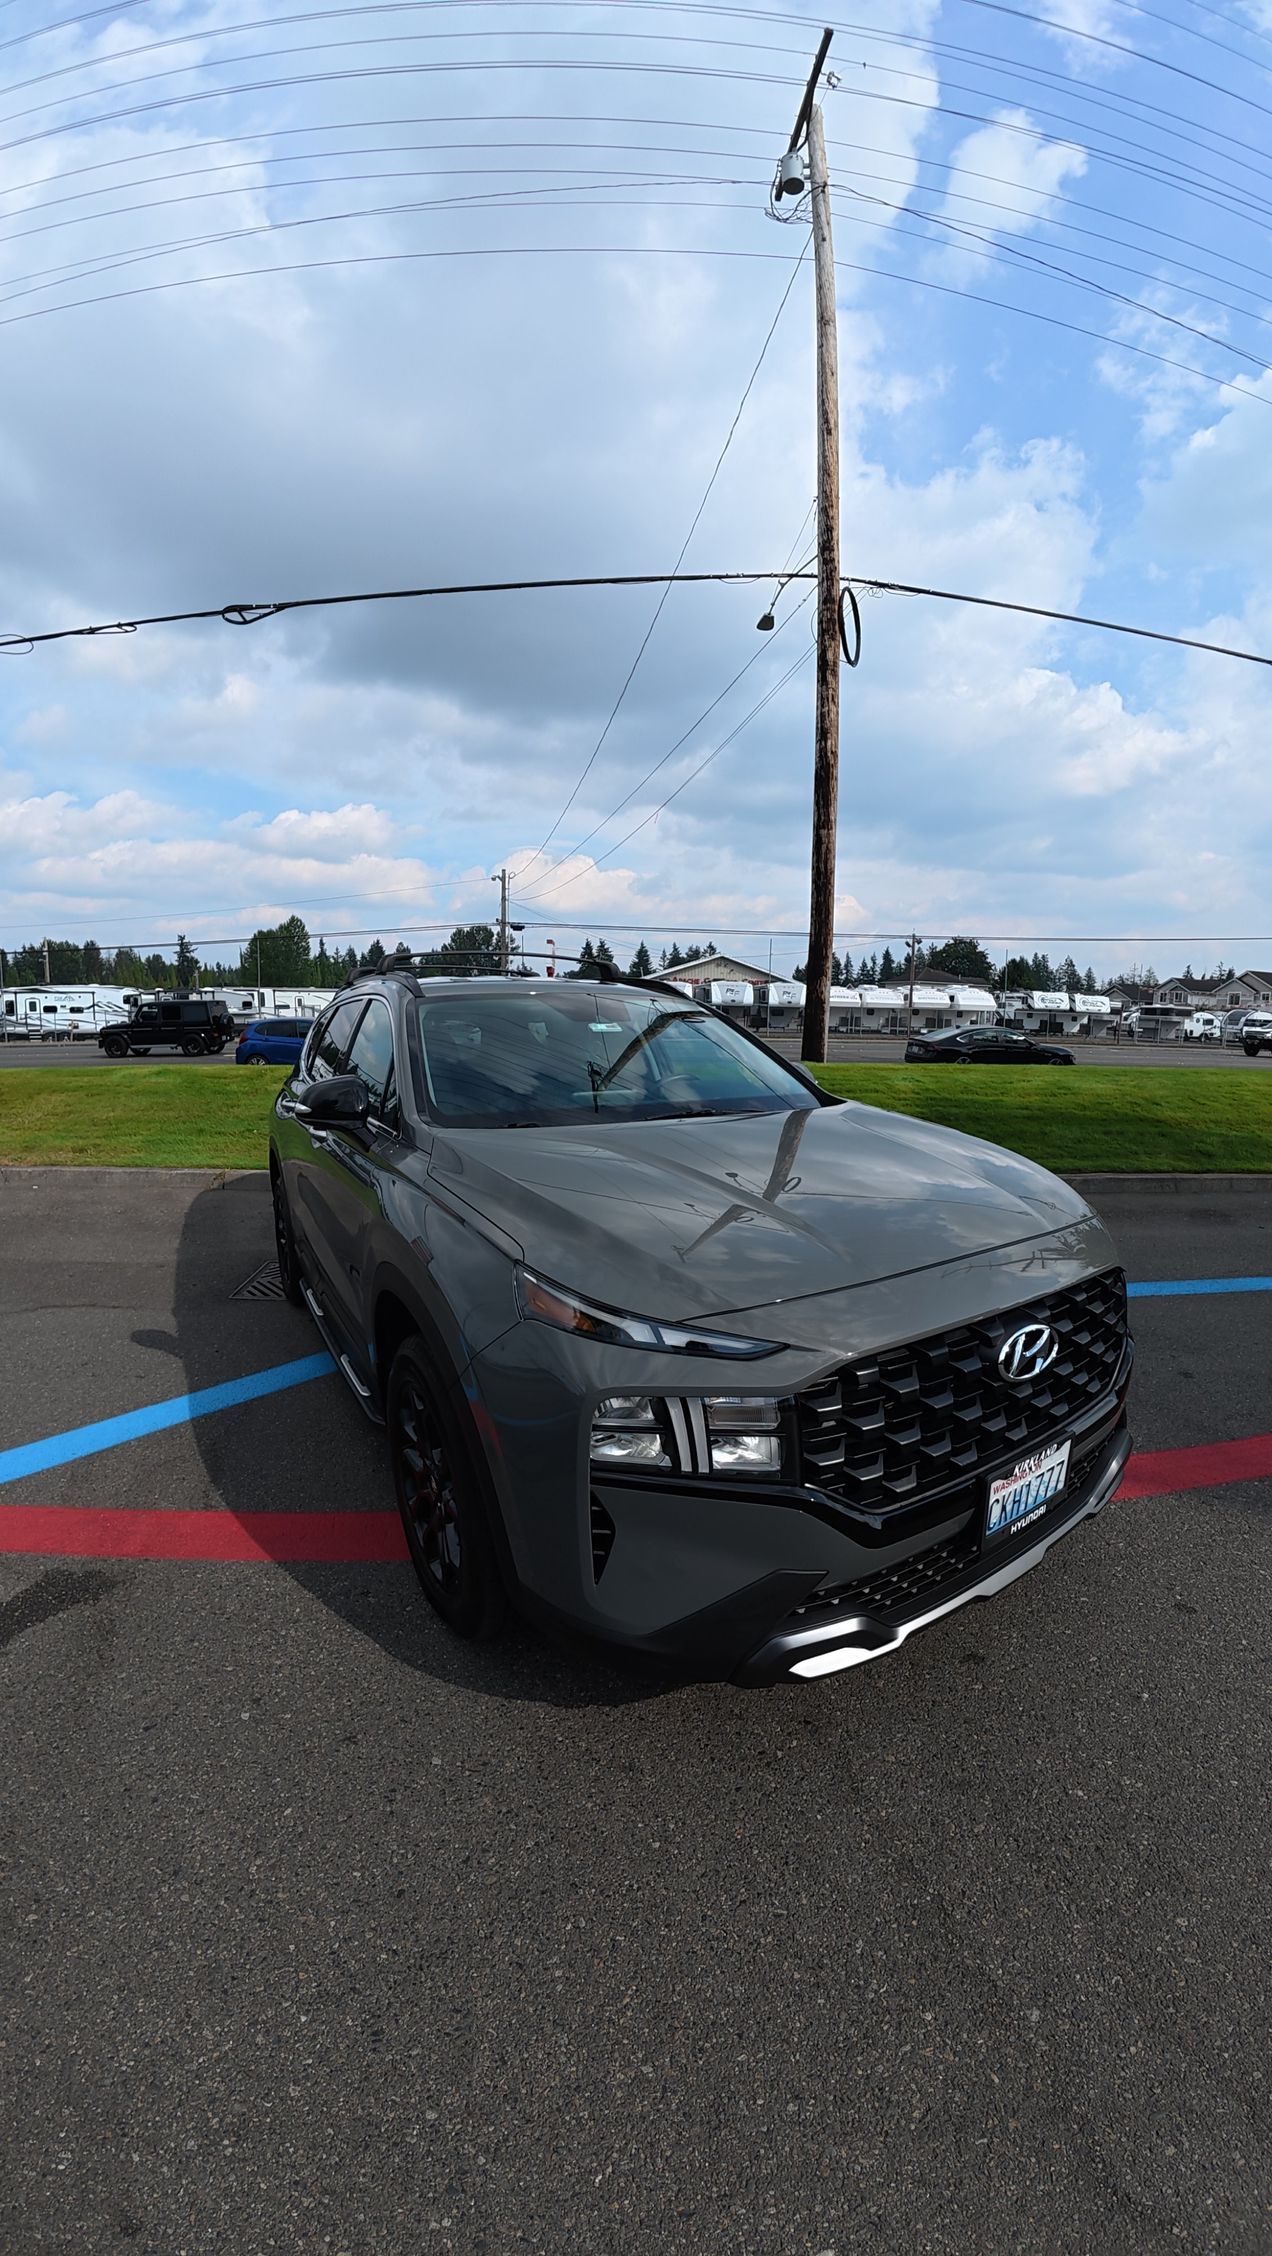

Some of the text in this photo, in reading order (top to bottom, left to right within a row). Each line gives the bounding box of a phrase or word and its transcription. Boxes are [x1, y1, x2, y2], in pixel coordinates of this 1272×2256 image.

[993, 1460, 1042, 1496] WASHINGN
[1012, 1443, 1058, 1479] KIRKLAND
[987, 1459, 1065, 1531] CKH1777
[1010, 1504, 1047, 1534] HYUNDAI
